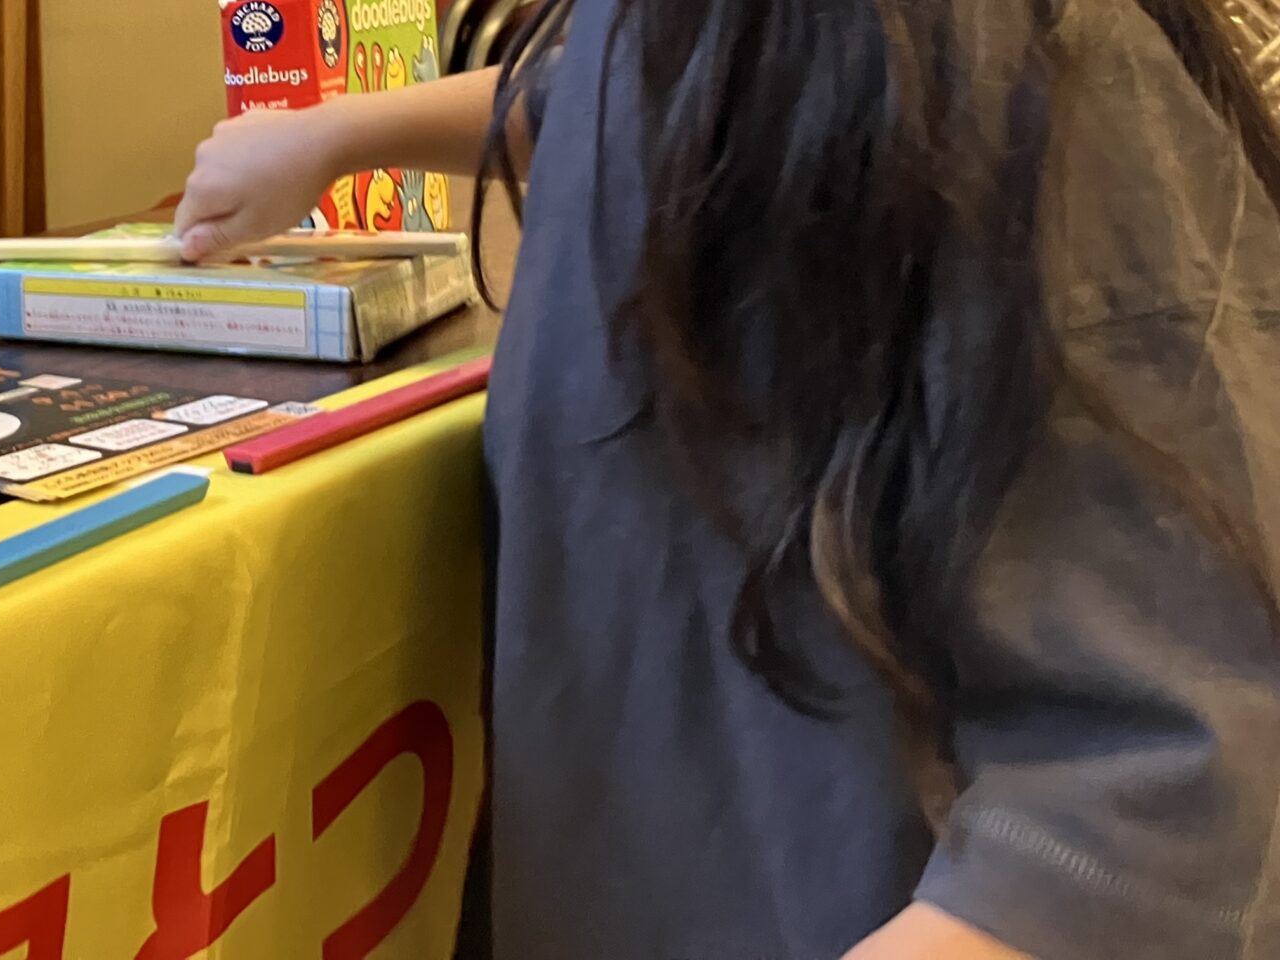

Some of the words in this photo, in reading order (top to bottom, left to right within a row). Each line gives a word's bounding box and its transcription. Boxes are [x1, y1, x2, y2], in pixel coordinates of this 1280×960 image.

[232, 1, 281, 26] ORCHARD
[244, 39, 274, 52] TOYS
[224, 65, 309, 87] doodlebugs
